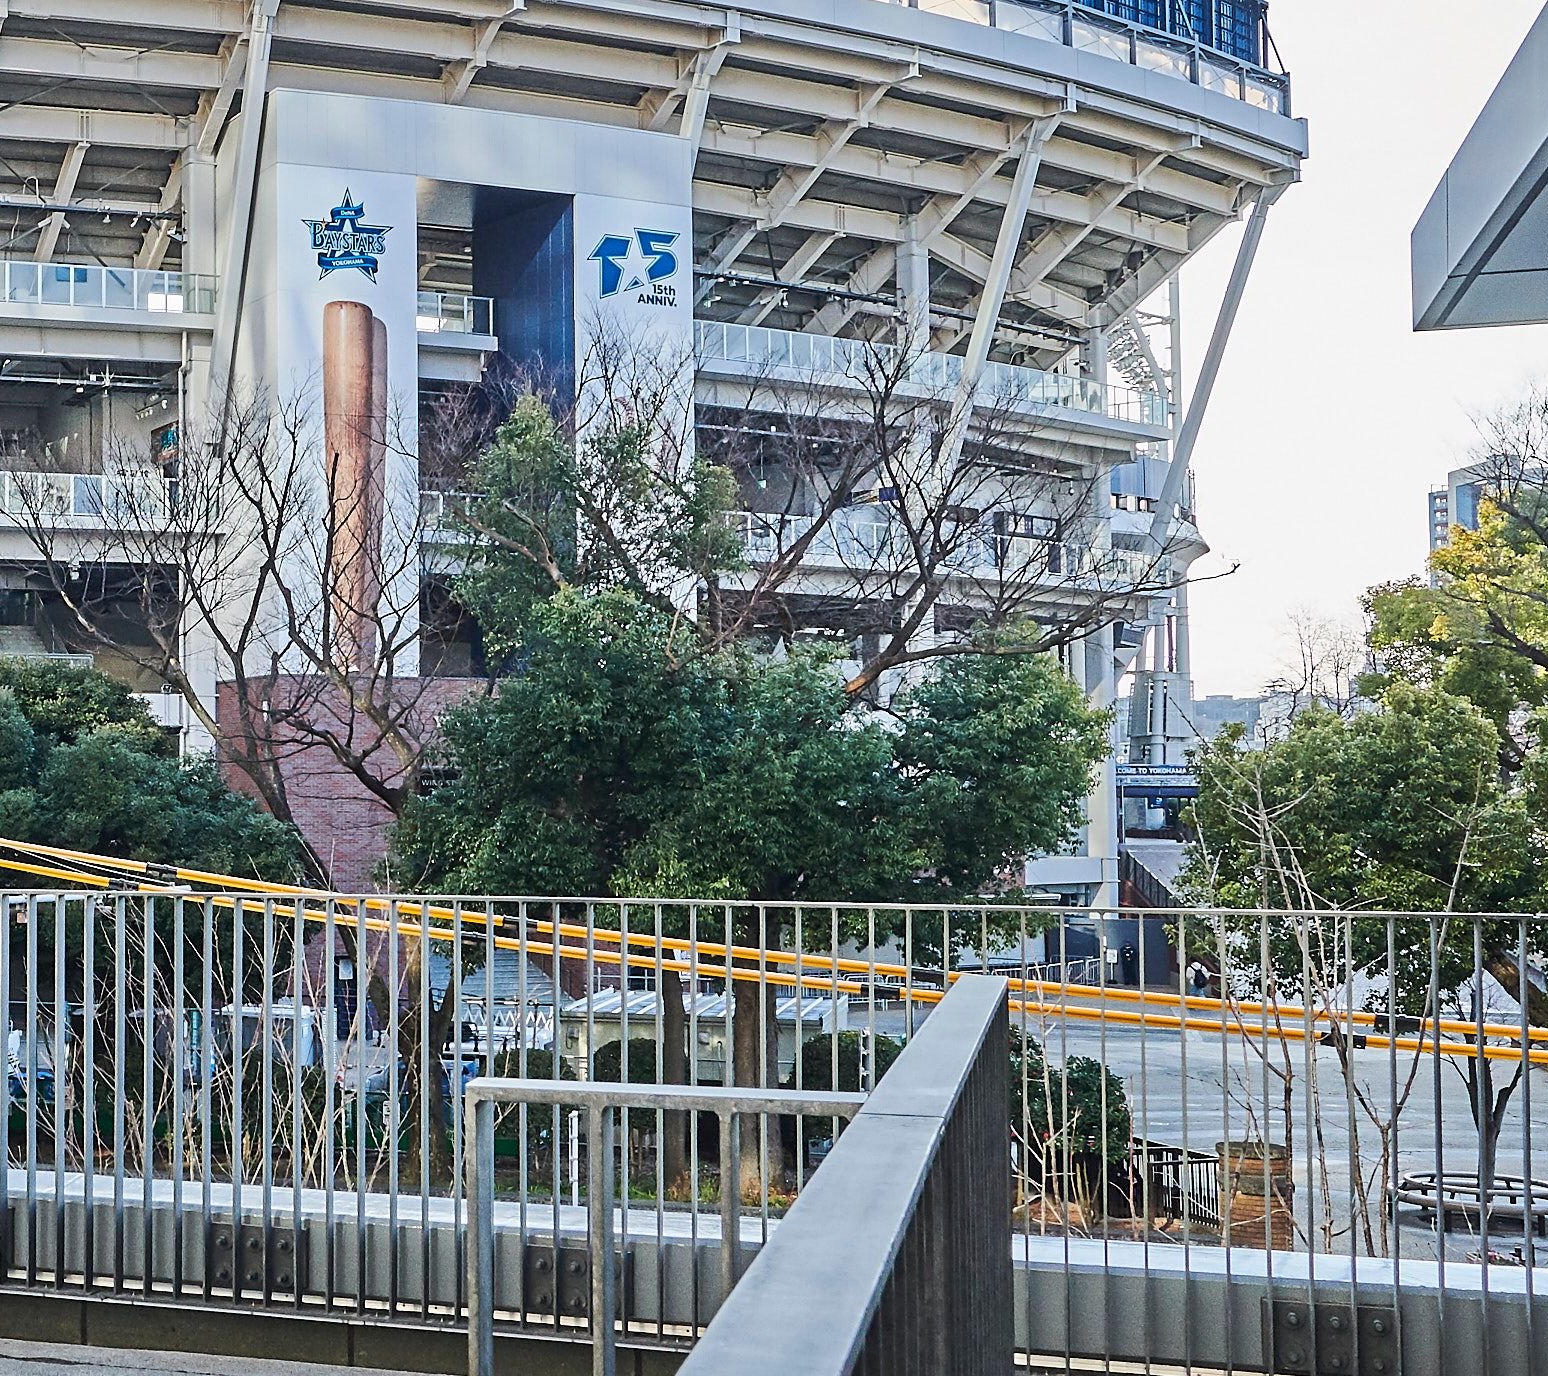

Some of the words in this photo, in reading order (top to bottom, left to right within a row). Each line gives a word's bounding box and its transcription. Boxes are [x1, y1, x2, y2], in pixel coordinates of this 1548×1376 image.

[310, 222, 386, 254] BAYSTARS
[331, 258, 364, 267] YOKOHAMA
[652, 283, 676, 297] 15th
[637, 293, 678, 307] ANNIV.
